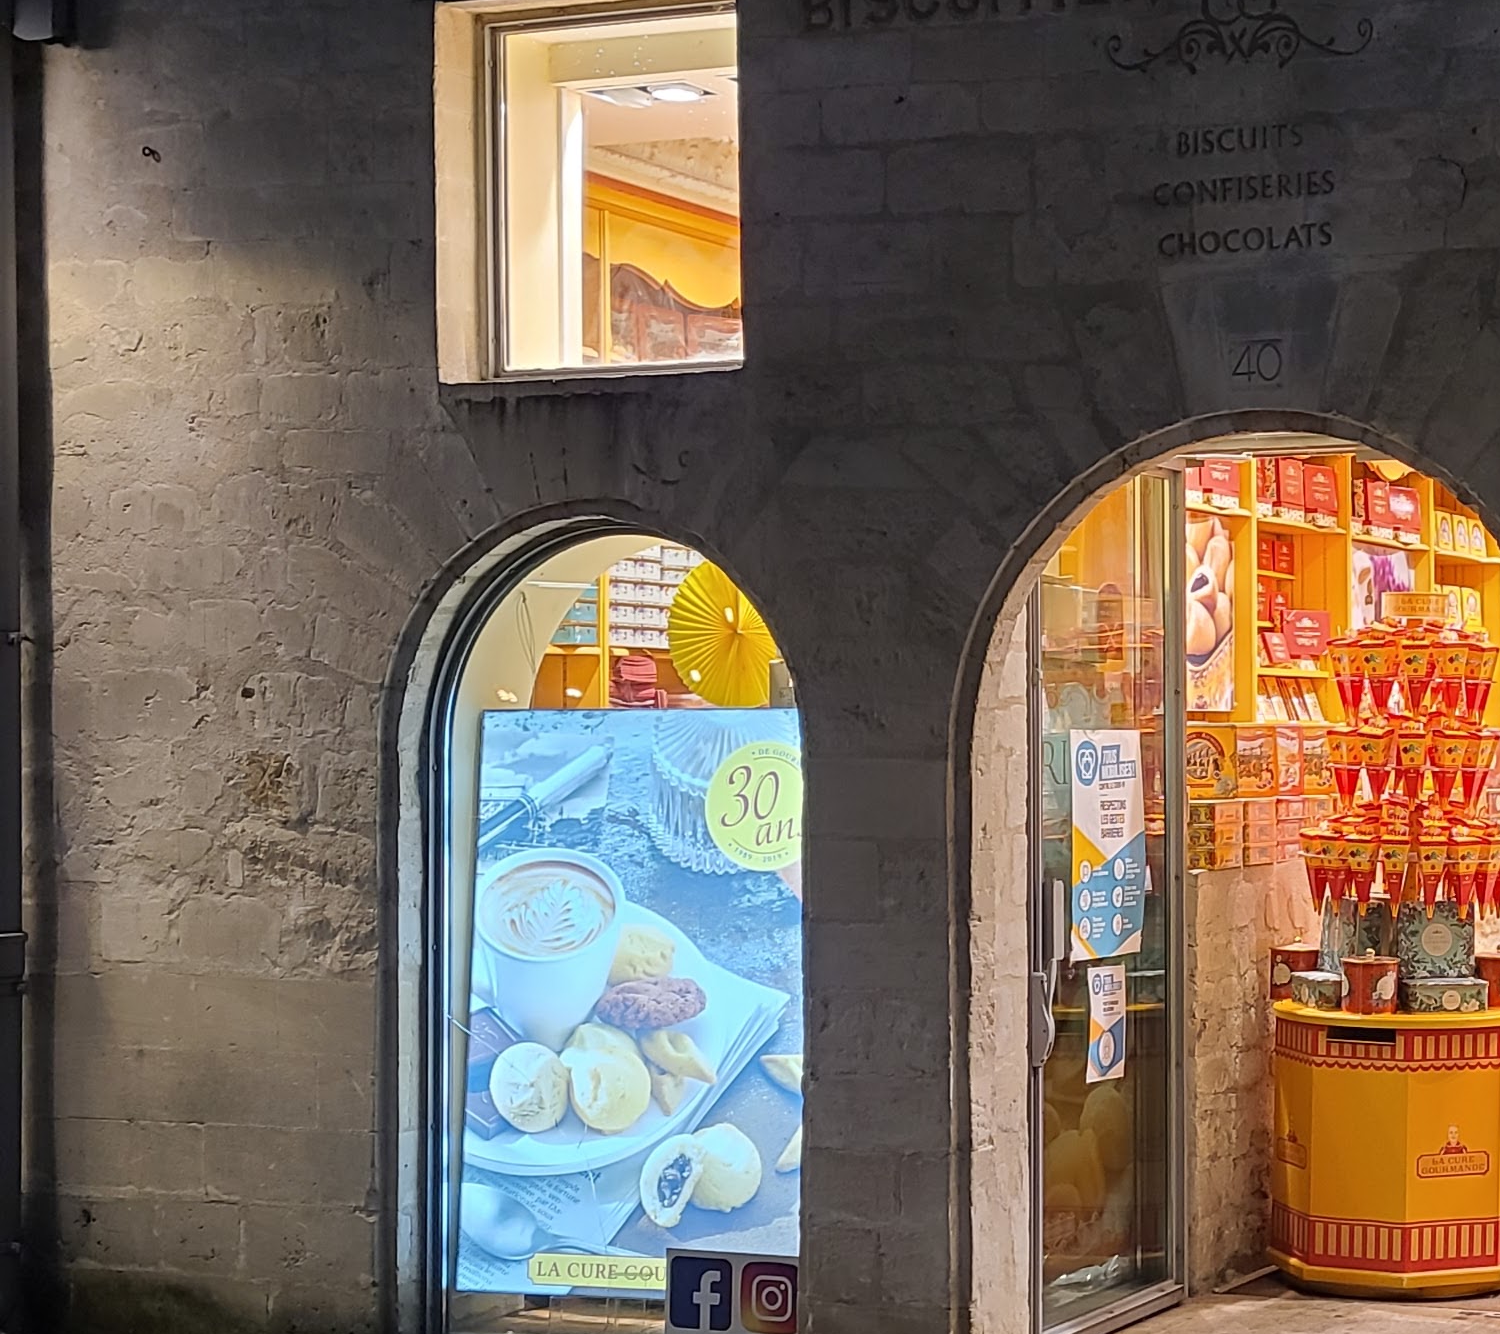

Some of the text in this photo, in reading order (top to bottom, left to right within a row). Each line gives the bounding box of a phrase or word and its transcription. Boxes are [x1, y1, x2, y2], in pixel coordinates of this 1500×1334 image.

[1177, 124, 1303, 155] BISCUITS
[1153, 170, 1335, 207] CONFISERIES
[1158, 222, 1333, 257] CHOCOLATS
[1232, 342, 1282, 383] 40
[758, 748, 800, 767] DE GOUR
[720, 765, 780, 827] 30
[1421, 1163, 1486, 1174] GOURMANDE
[1448, 1156, 1475, 1164] CURE
[536, 1261, 561, 1278] LA
[567, 1261, 619, 1280] CURE
